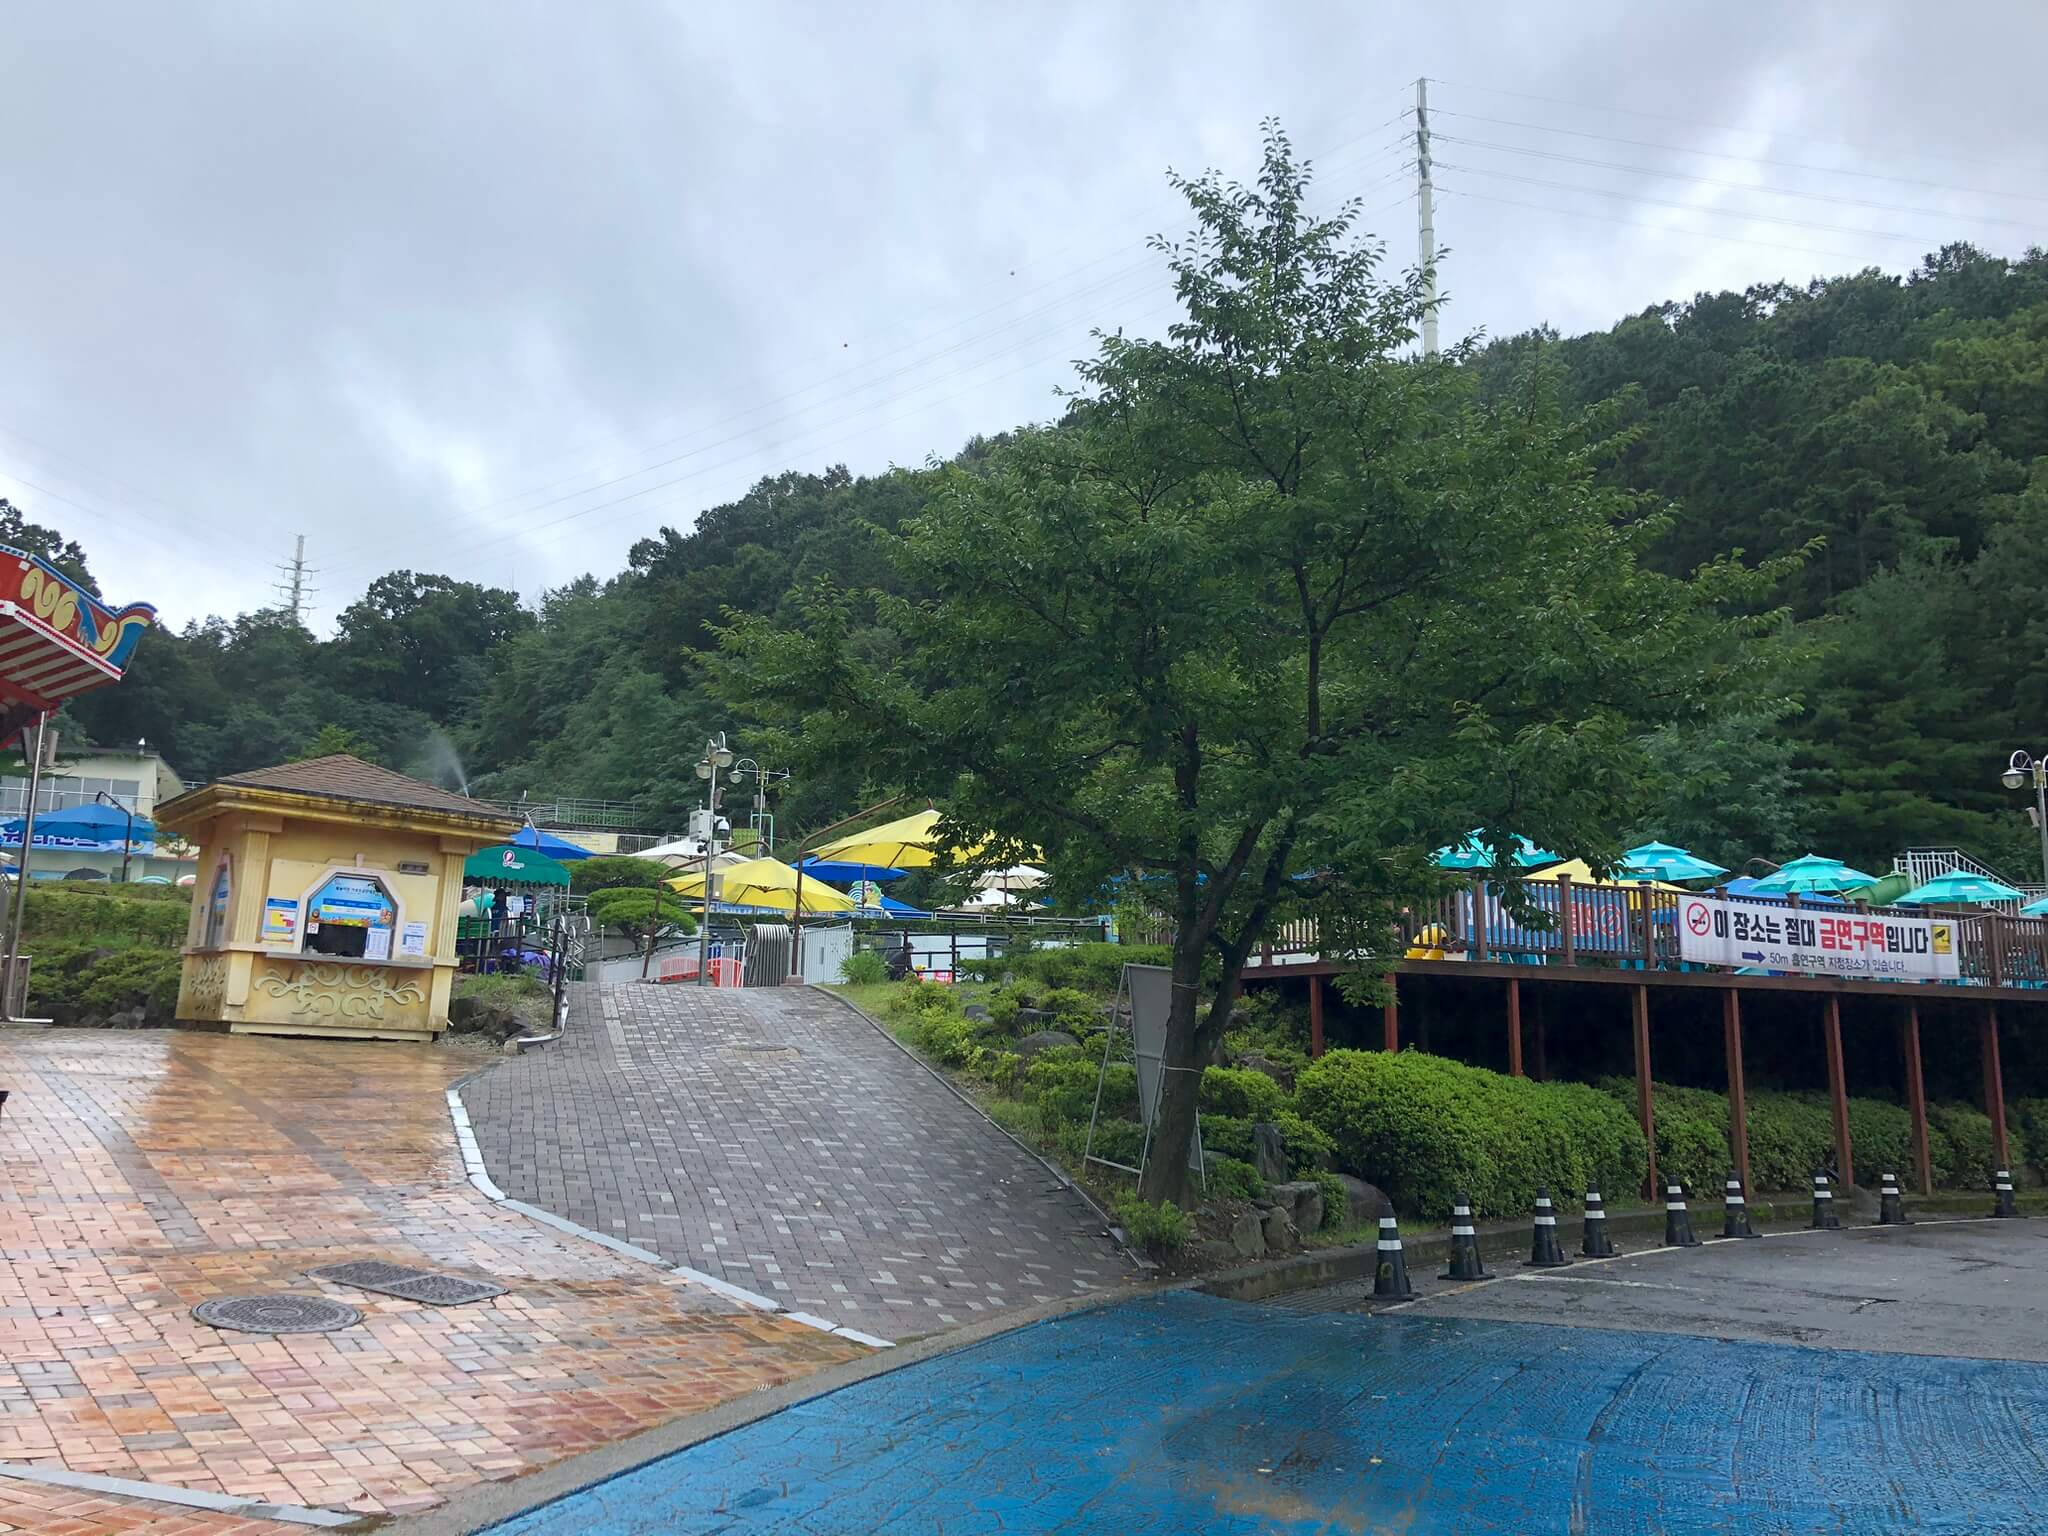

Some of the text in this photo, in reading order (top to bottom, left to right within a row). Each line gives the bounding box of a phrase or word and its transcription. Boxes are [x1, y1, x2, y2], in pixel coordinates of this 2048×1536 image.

[1714, 909, 1929, 954] 이 장소는 절대 금연구역입니다
[1769, 952, 1789, 965] 50m
[1791, 953, 1826, 968] 흡연구역
[1828, 956, 1870, 972] 지정장소가
